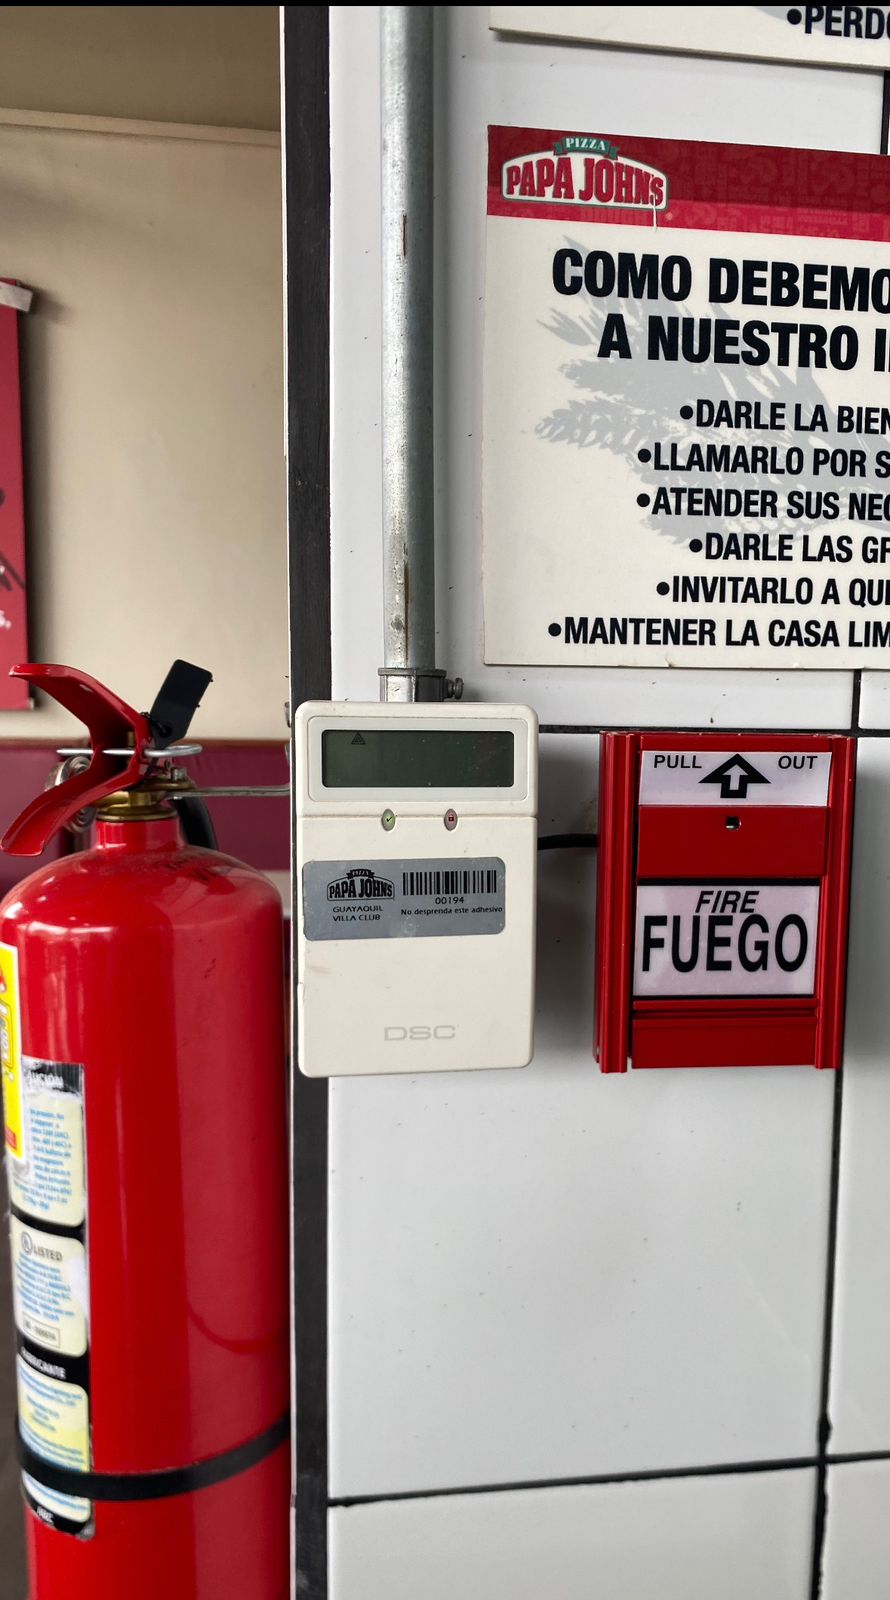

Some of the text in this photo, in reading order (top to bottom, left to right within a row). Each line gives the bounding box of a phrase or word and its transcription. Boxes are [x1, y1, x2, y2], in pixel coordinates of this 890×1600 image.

[804, 5, 890, 41] PERD
[565, 137, 607, 151] PIZZA
[506, 157, 575, 199] PAPA
[552, 247, 693, 302] COMO
[596, 313, 890, 372] A NUESTRO I
[696, 399, 786, 431] DARLE
[794, 404, 829, 432] LA
[653, 442, 804, 476] LLAMARLO
[813, 447, 867, 478] POR
[651, 486, 778, 519] ATENDER
[785, 491, 840, 520] SUS
[705, 532, 793, 561] DARLE
[801, 534, 854, 563] LAS
[672, 575, 814, 605] INVITARLO
[821, 578, 841, 605] A
[563, 616, 717, 646] MANTENER
[725, 619, 760, 647] LA
[768, 619, 840, 648] CASA
[653, 754, 818, 770] PULL OUT
[329, 878, 357, 898] PAPA
[435, 896, 465, 905] 00194
[695, 889, 760, 914] FIRE
[332, 905, 384, 913] GUAYAQUIL
[414, 907, 452, 916] desprenda
[641, 912, 809, 973] FUEGO
[384, 1024, 457, 1042] DSC
[32, 1244, 63, 1262] LISTED
